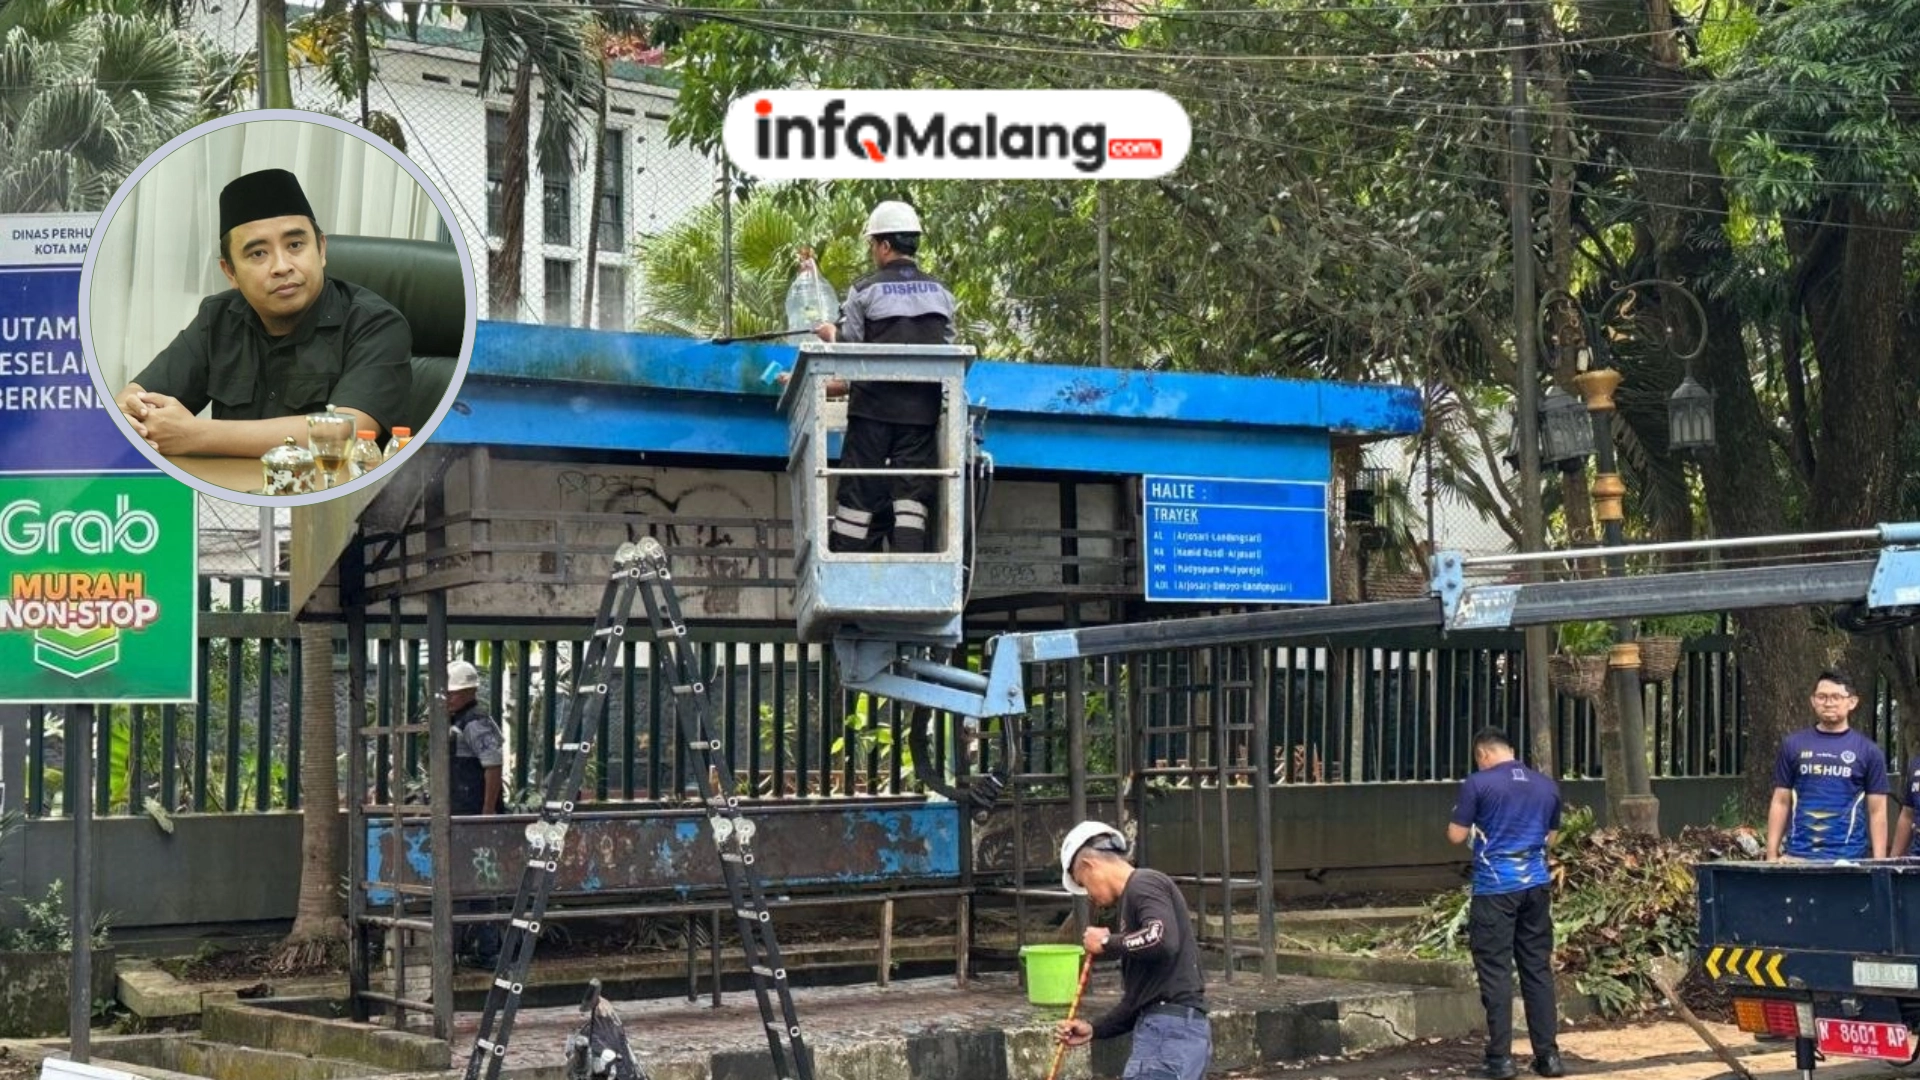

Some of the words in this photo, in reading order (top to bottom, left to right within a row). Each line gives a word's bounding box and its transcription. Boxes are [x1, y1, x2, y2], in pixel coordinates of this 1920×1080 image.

[12, 228, 50, 241] DINAS
[34, 243, 67, 255] KOTA
[882, 282, 939, 296] DISHUB
[2, 316, 80, 341] UTAM
[1152, 483, 1196, 499] HALTE
[1153, 507, 1198, 524] TRAYEK
[0, 494, 159, 555] Grab
[12, 573, 143, 601] MURAH
[0, 599, 158, 628] NON-STOP
[1800, 763, 1852, 778] DISHUB
[1819, 1021, 1830, 1042] N
[1840, 1023, 1879, 1046] 8601
[1886, 1026, 1906, 1048] AP
